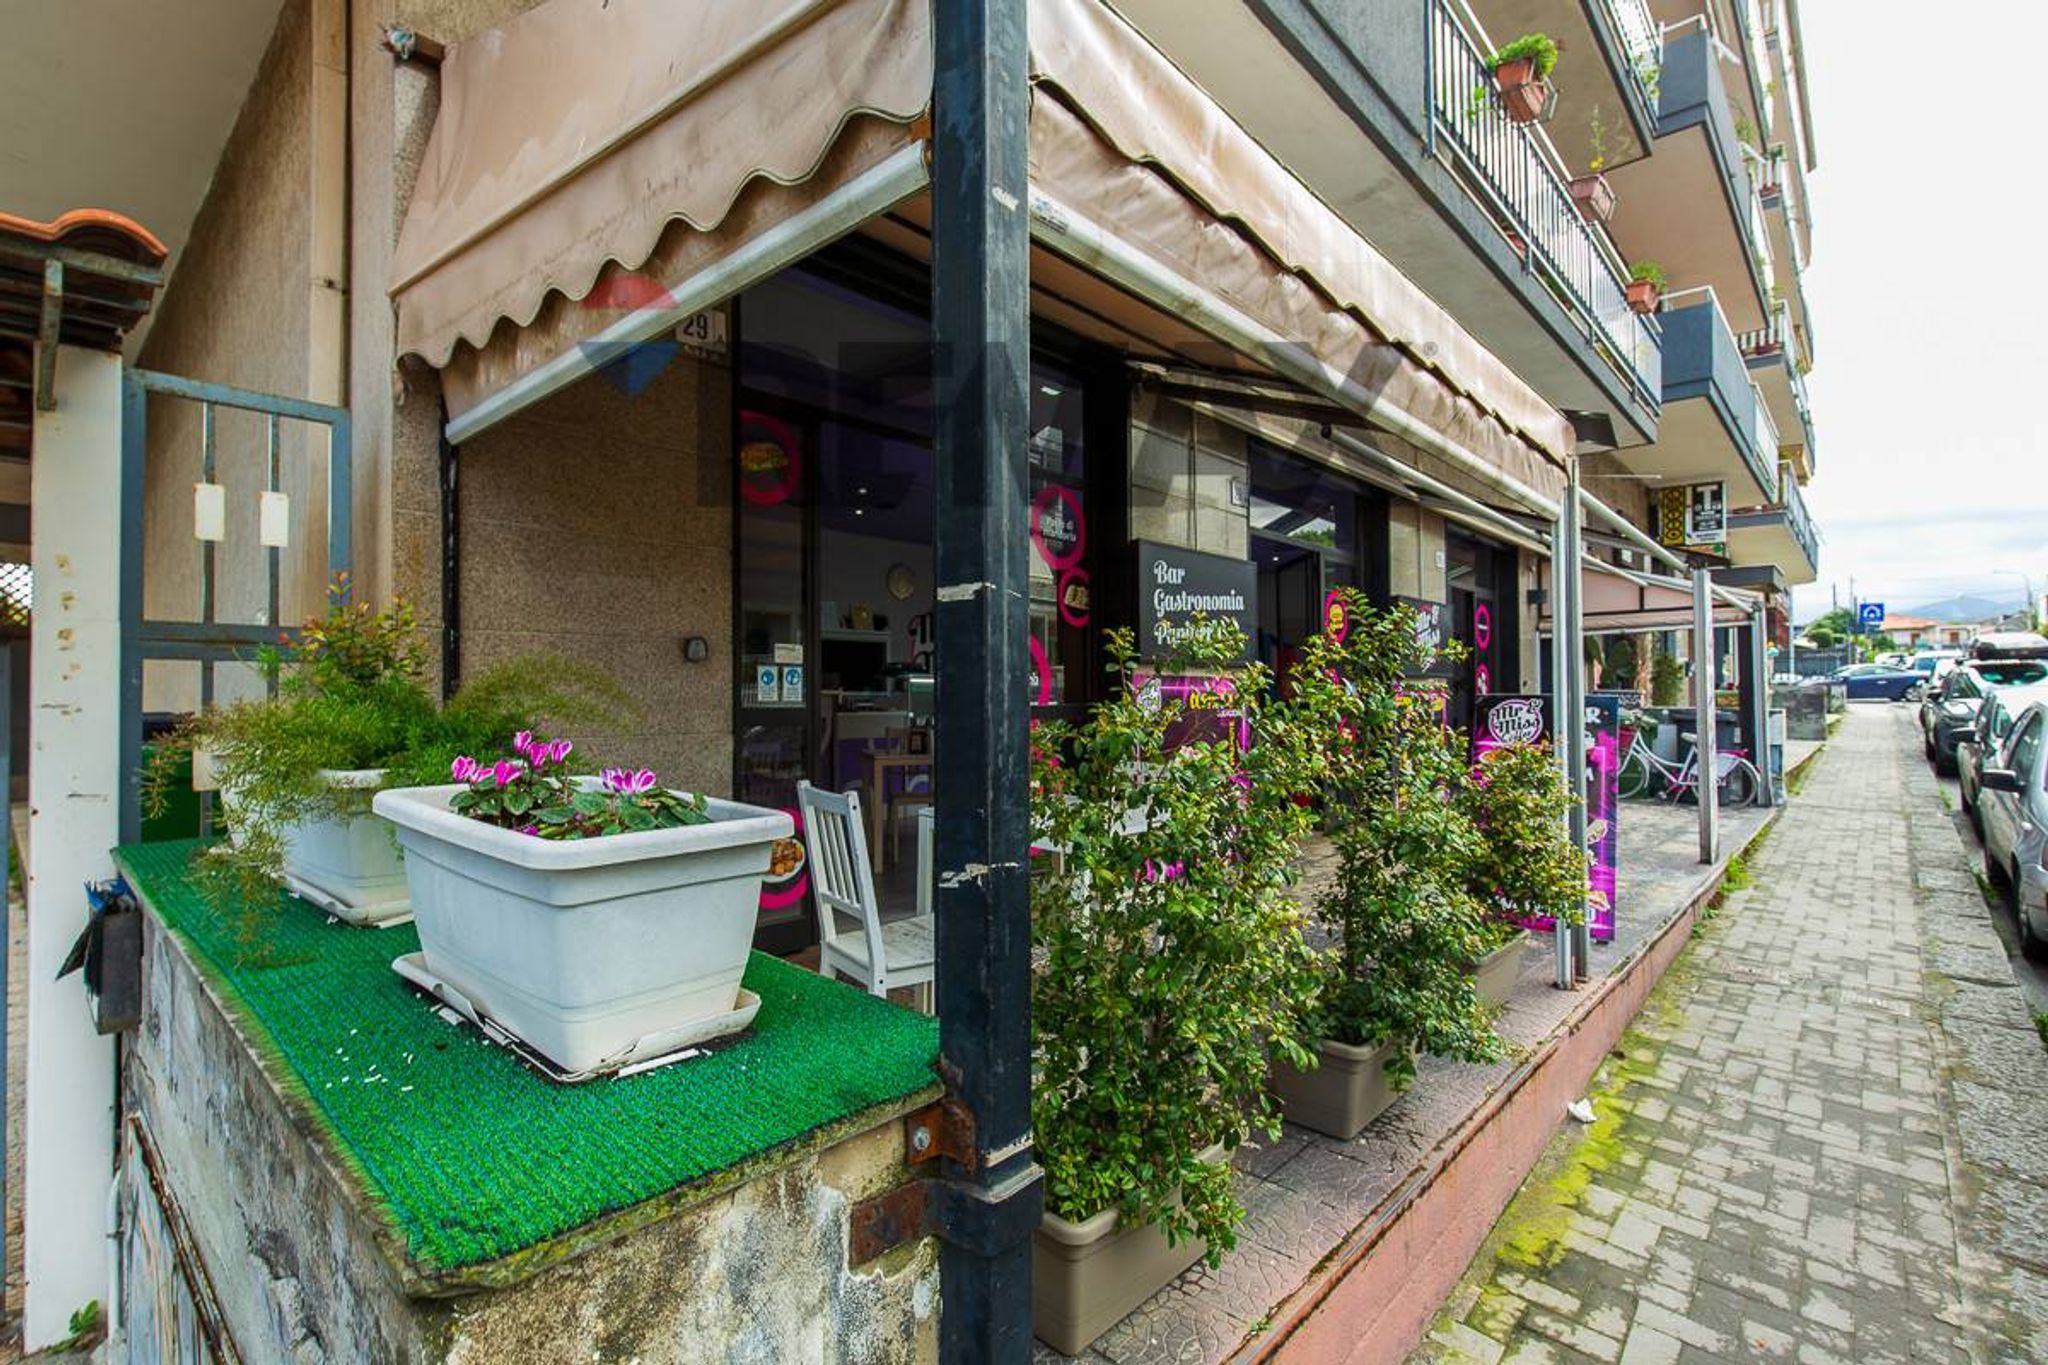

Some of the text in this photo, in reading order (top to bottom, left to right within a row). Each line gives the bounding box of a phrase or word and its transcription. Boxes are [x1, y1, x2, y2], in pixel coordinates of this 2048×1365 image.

[683, 314, 708, 340] 29
[1154, 560, 1185, 584] Bar
[1154, 589, 1244, 617] Gastronomia
[1491, 698, 1543, 720] Mr &
